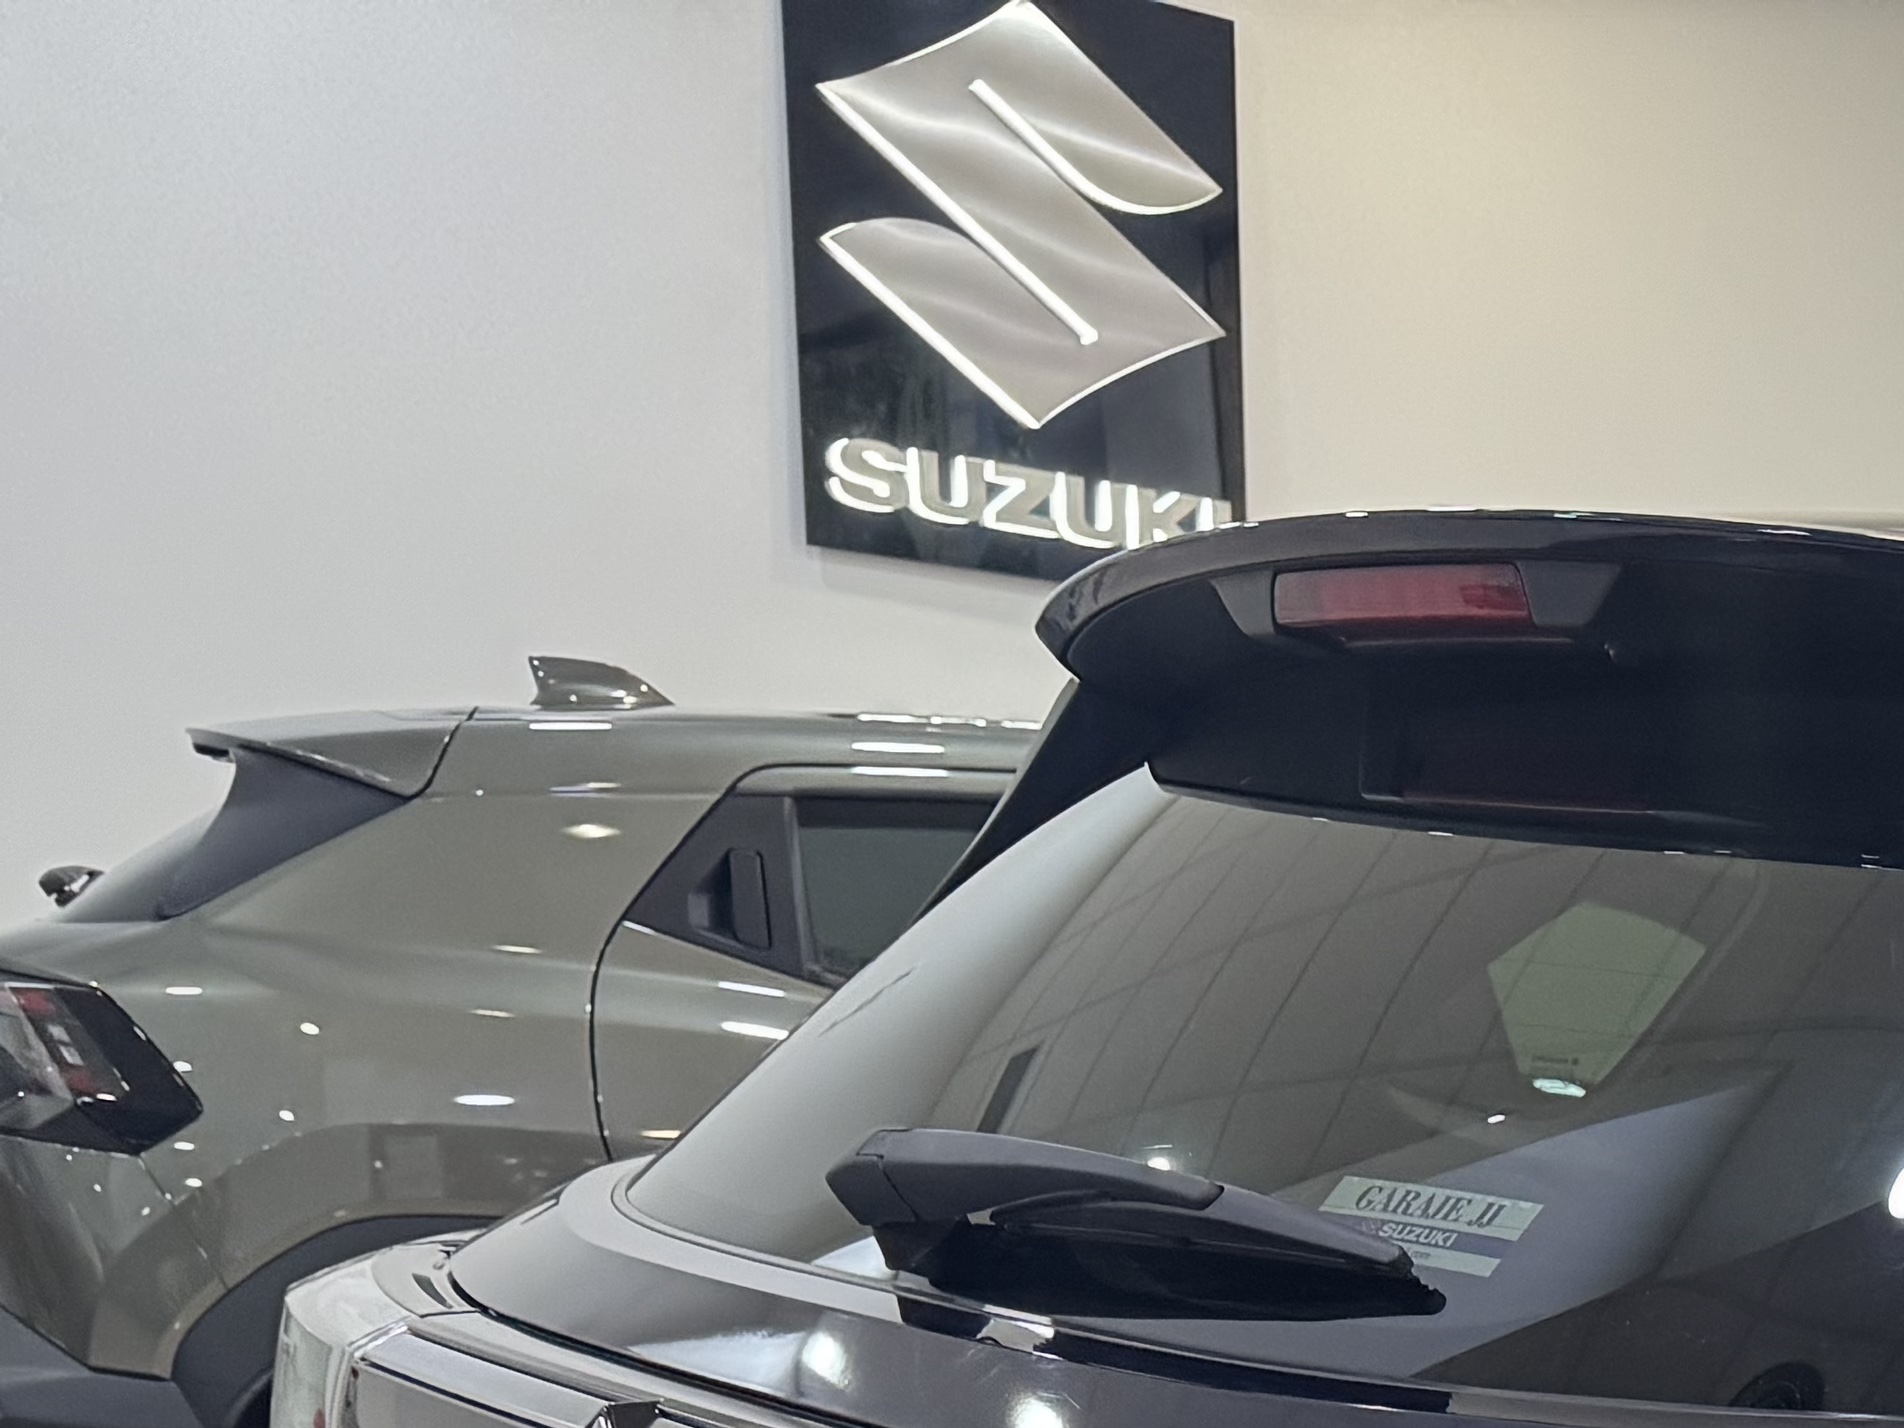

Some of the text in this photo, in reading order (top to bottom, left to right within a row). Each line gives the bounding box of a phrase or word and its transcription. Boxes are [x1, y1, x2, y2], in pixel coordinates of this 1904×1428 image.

[824, 437, 1232, 551] SUZUKI
[1353, 1184, 1473, 1225] GARAJE
[1378, 1221, 1458, 1248] SUZUKI
